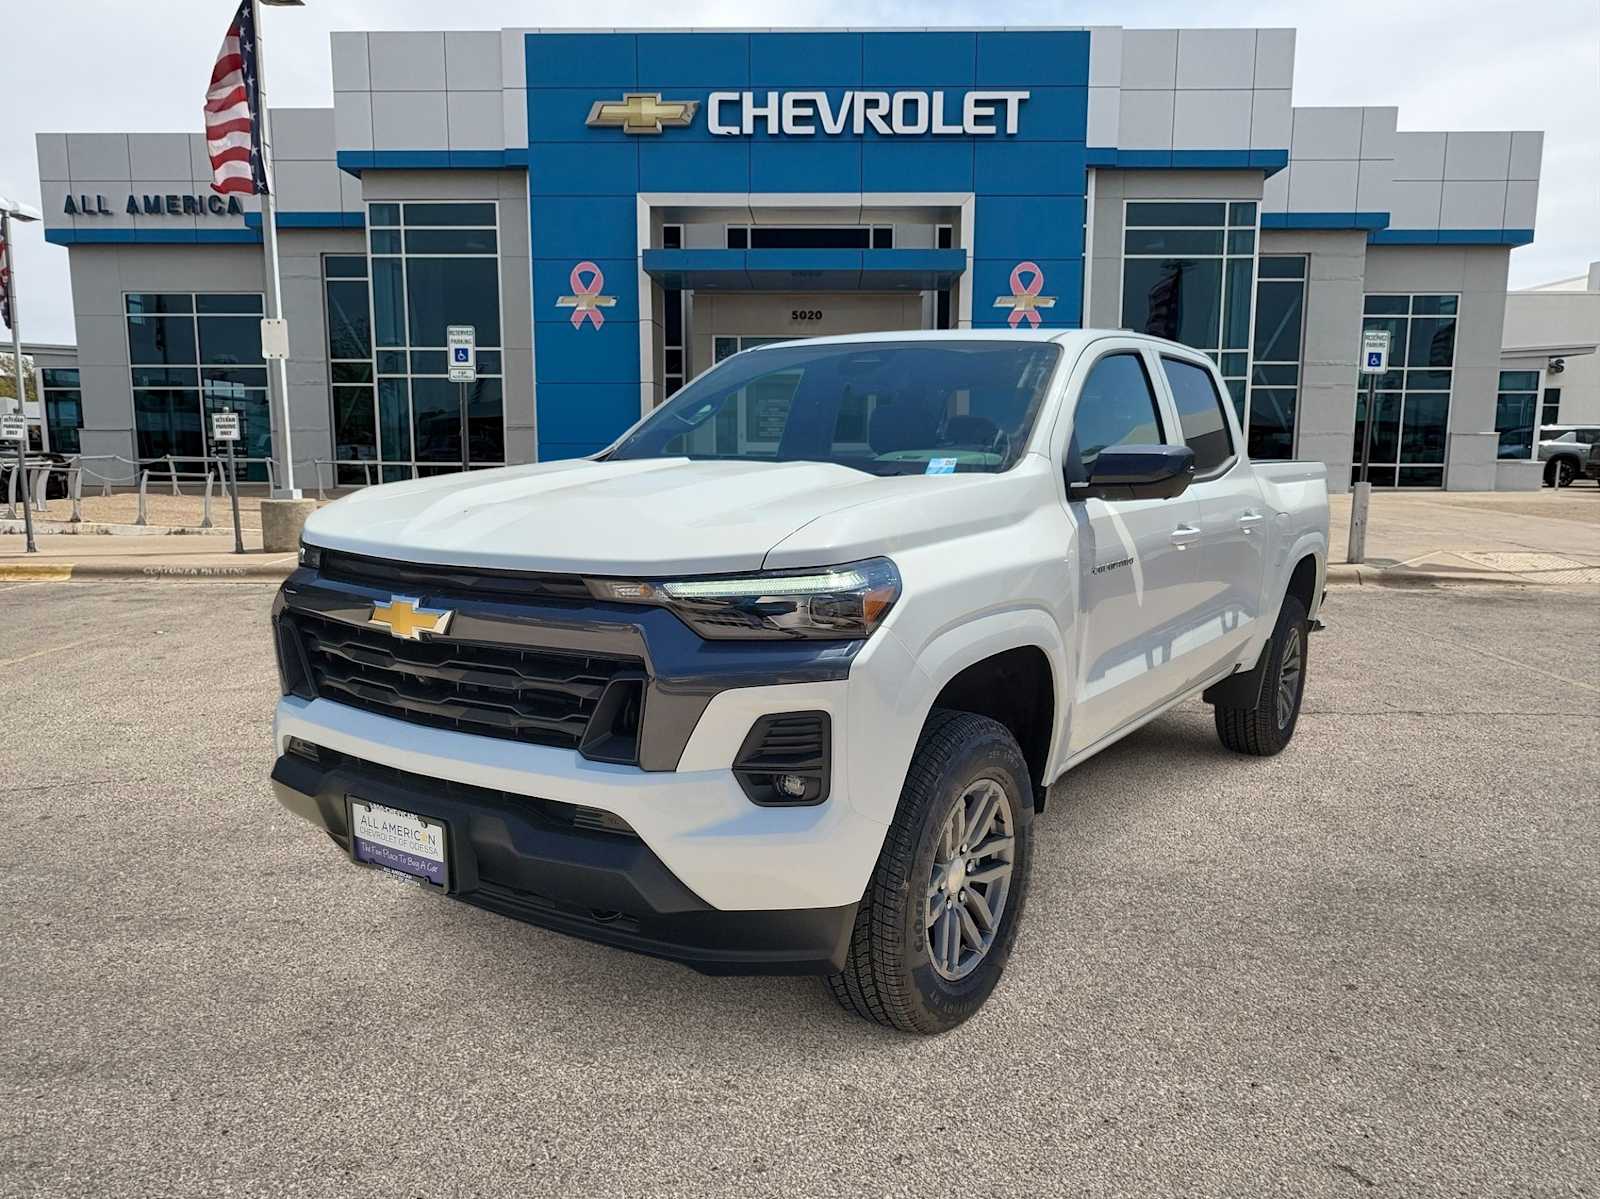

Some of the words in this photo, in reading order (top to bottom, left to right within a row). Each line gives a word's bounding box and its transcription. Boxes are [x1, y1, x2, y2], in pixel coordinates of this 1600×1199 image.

[707, 90, 1031, 136] CHEVROLET
[64, 194, 113, 216] ALL
[126, 194, 245, 216] AMERICA
[791, 310, 823, 320] 5020
[360, 815, 380, 830] ALL
